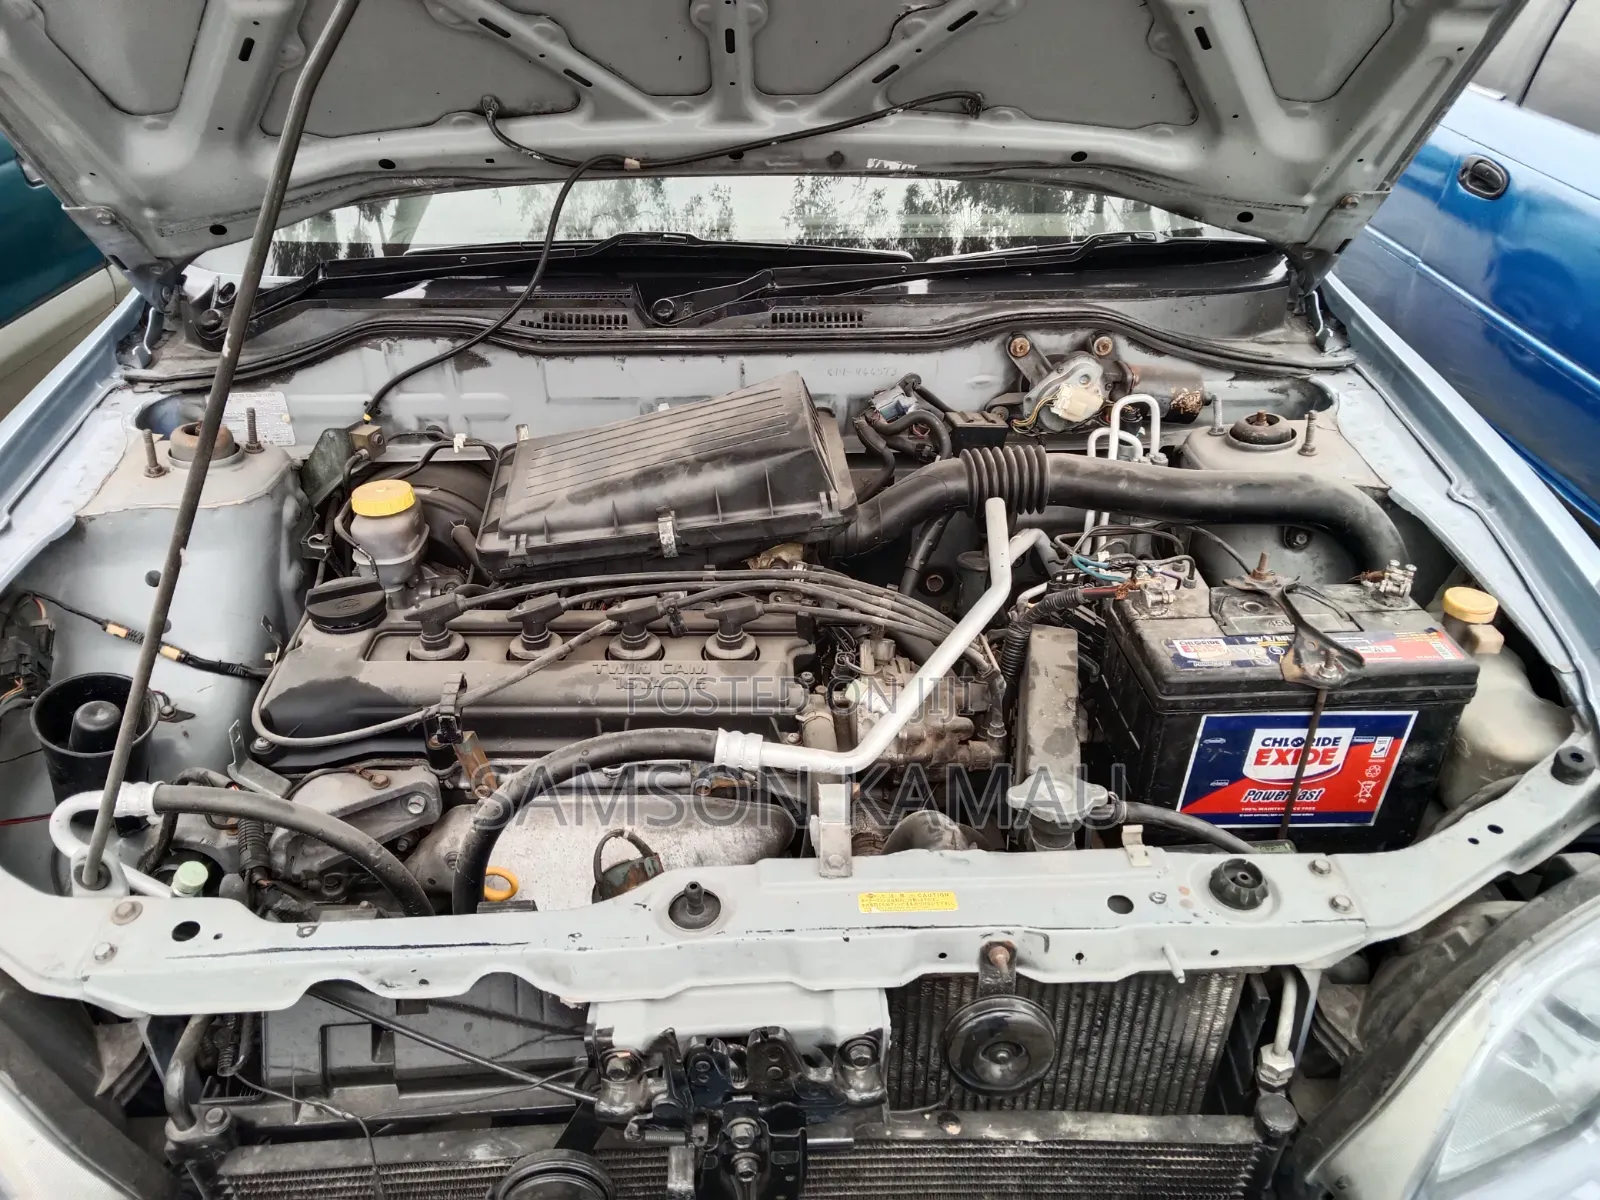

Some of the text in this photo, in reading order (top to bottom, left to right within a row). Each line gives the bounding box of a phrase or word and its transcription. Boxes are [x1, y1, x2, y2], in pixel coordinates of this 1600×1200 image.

[593, 663, 708, 675] TWIN CAM
[1254, 748, 1339, 765] EXIDE
